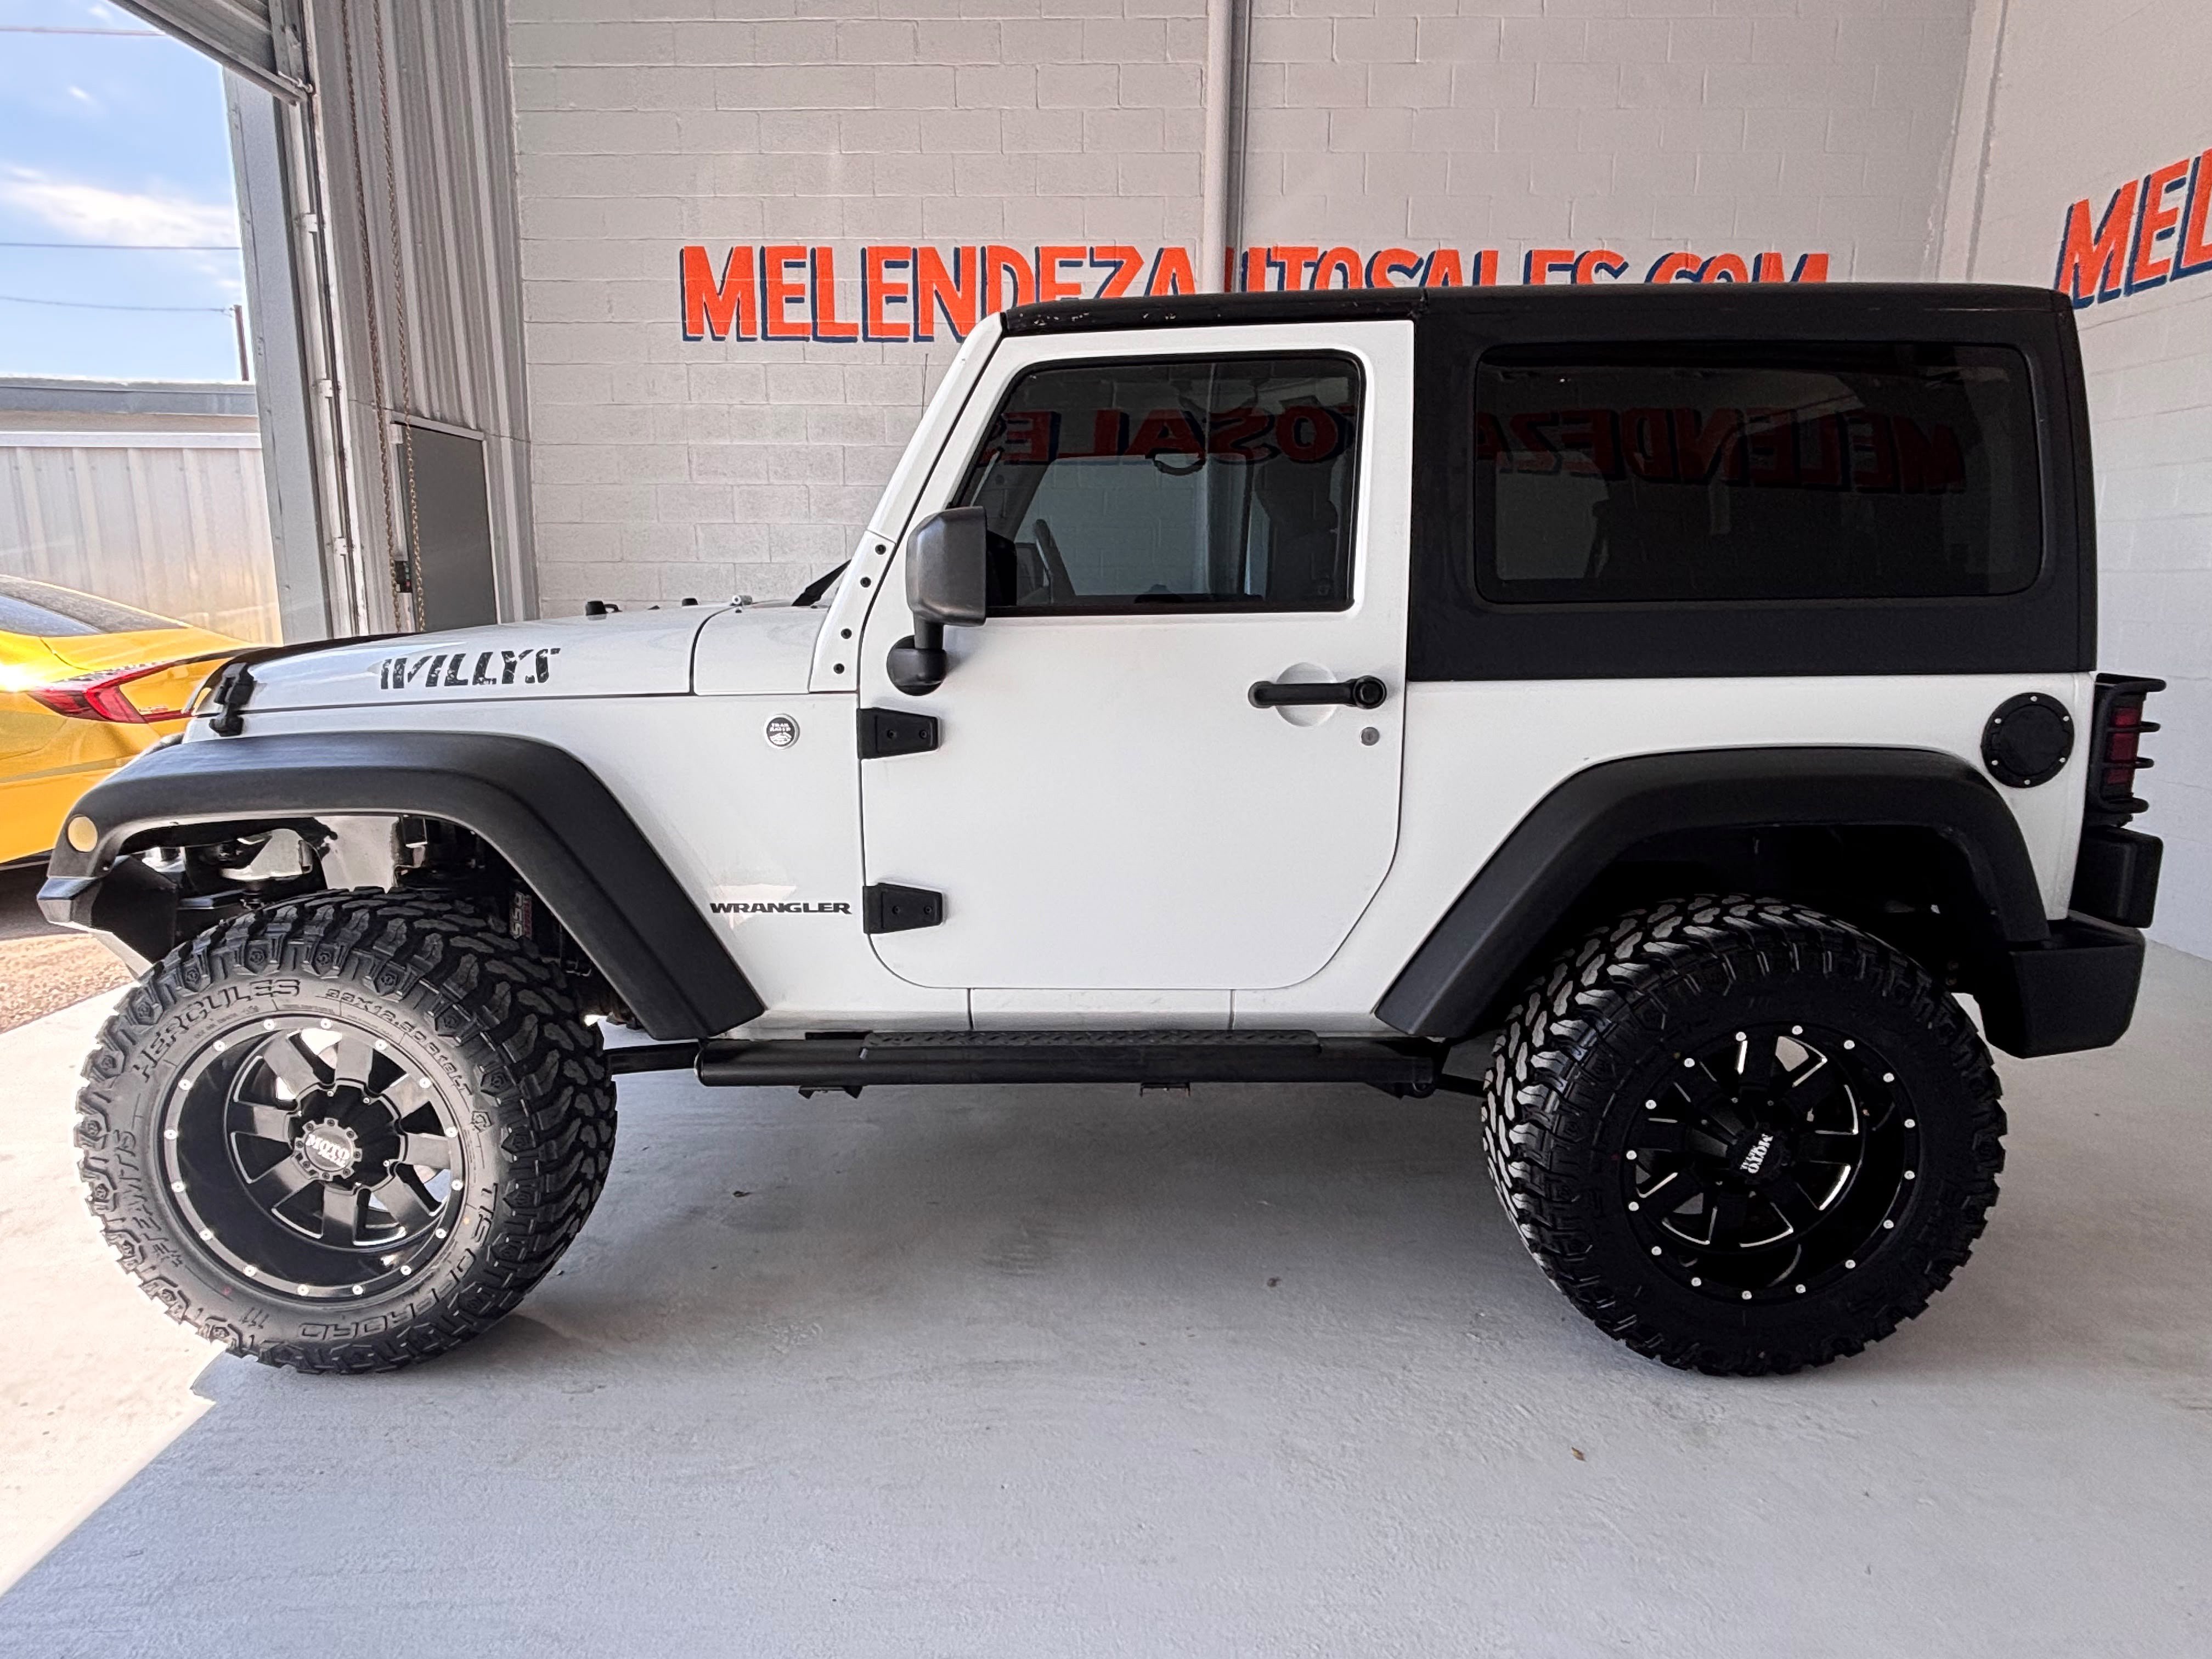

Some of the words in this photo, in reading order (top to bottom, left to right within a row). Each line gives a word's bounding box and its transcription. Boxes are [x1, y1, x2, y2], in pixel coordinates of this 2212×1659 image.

[381, 648, 561, 689] WILLYS
[710, 903, 852, 915] WRANGLER
[133, 979, 301, 1084] HERCULES
[306, 1134, 350, 1160] MOTO
[1748, 1133, 1774, 1173] MOTO
